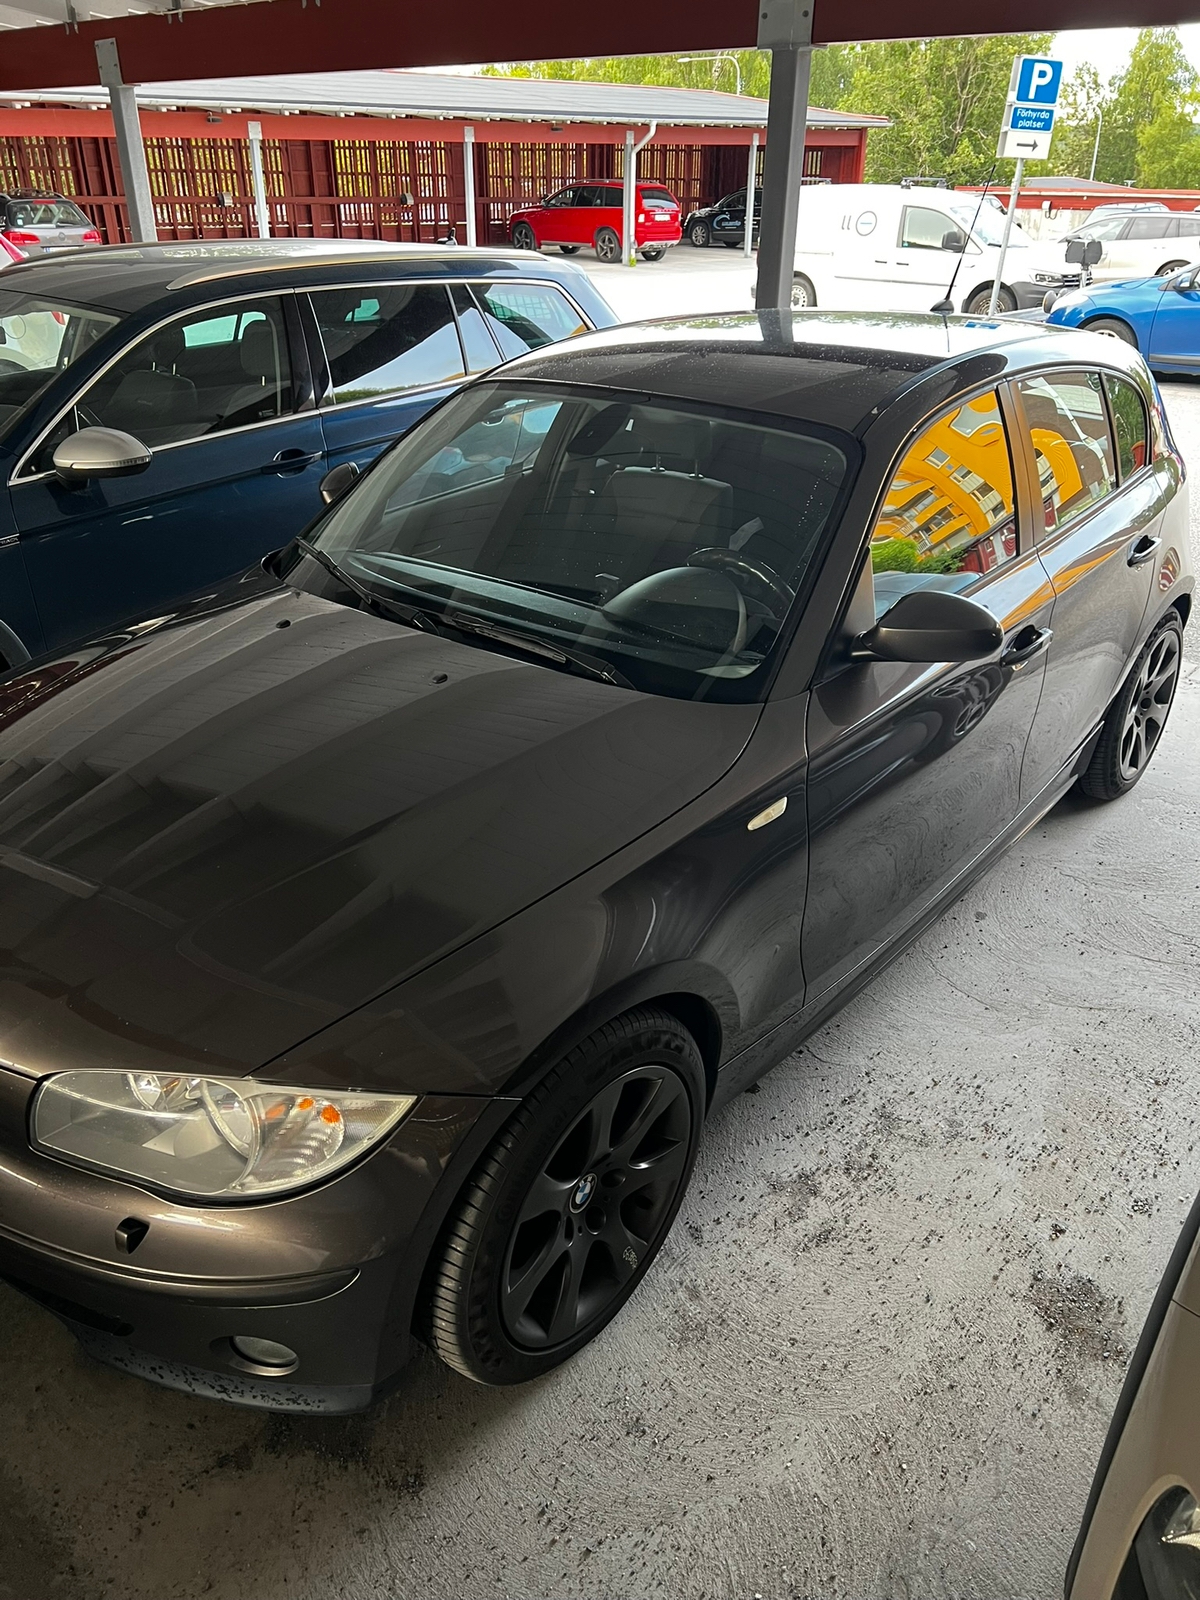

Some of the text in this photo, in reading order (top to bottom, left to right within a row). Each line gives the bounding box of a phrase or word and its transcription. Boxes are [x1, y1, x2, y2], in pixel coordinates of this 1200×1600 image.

[1028, 62, 1053, 100] P
[1016, 108, 1050, 119] Förhyrda
[1017, 119, 1045, 129] platser
